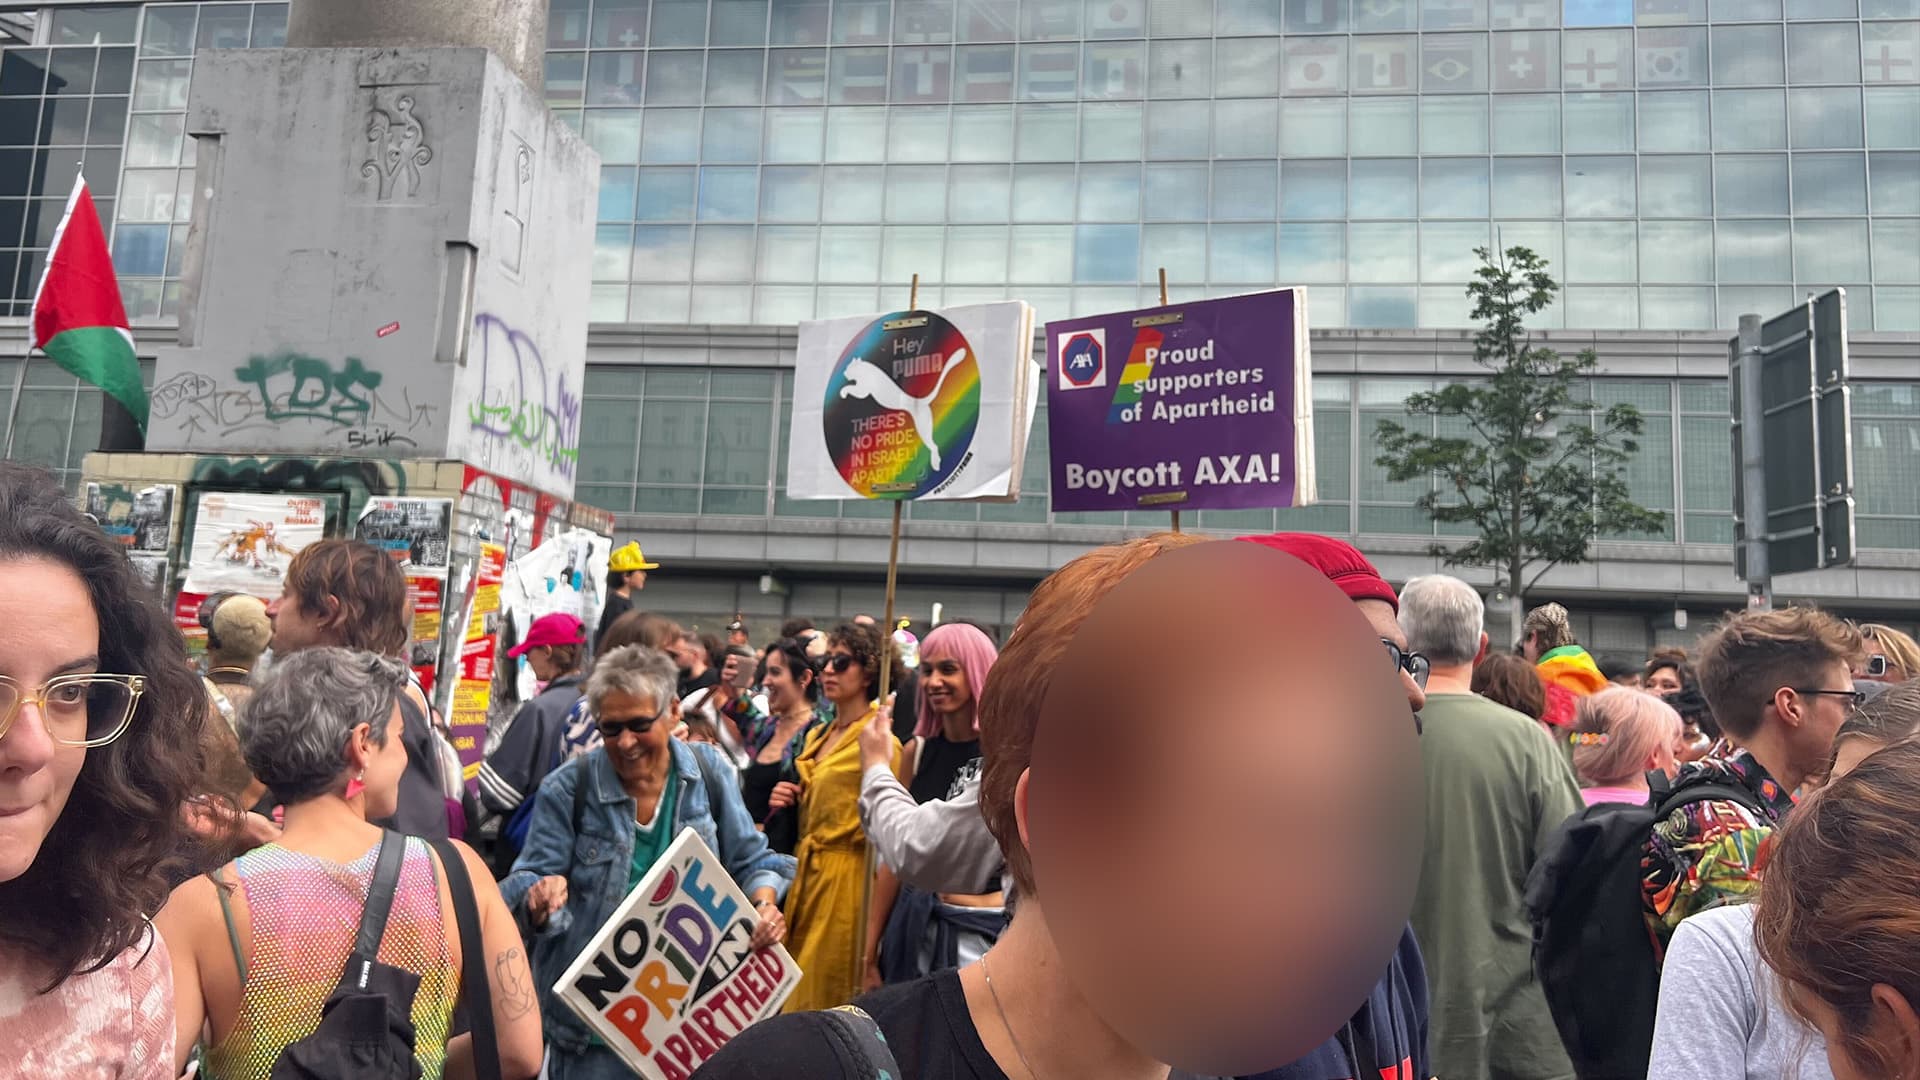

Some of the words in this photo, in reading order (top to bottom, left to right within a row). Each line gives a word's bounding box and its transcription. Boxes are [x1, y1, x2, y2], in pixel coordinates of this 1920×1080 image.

[893, 338, 927, 355] Hey
[1144, 339, 1214, 367] Proud
[893, 352, 943, 378] PUMA
[1069, 353, 1093, 369] AXA
[1133, 366, 1264, 396] supporters
[1120, 401, 1143, 423] of
[1151, 391, 1275, 424] Apartheid
[851, 435, 872, 451] NO
[876, 428, 915, 448] PRIDE
[851, 453, 864, 468] IN
[1066, 461, 1181, 494] Boycott
[1194, 453, 1280, 485] AXA!
[574, 917, 649, 1012] NO
